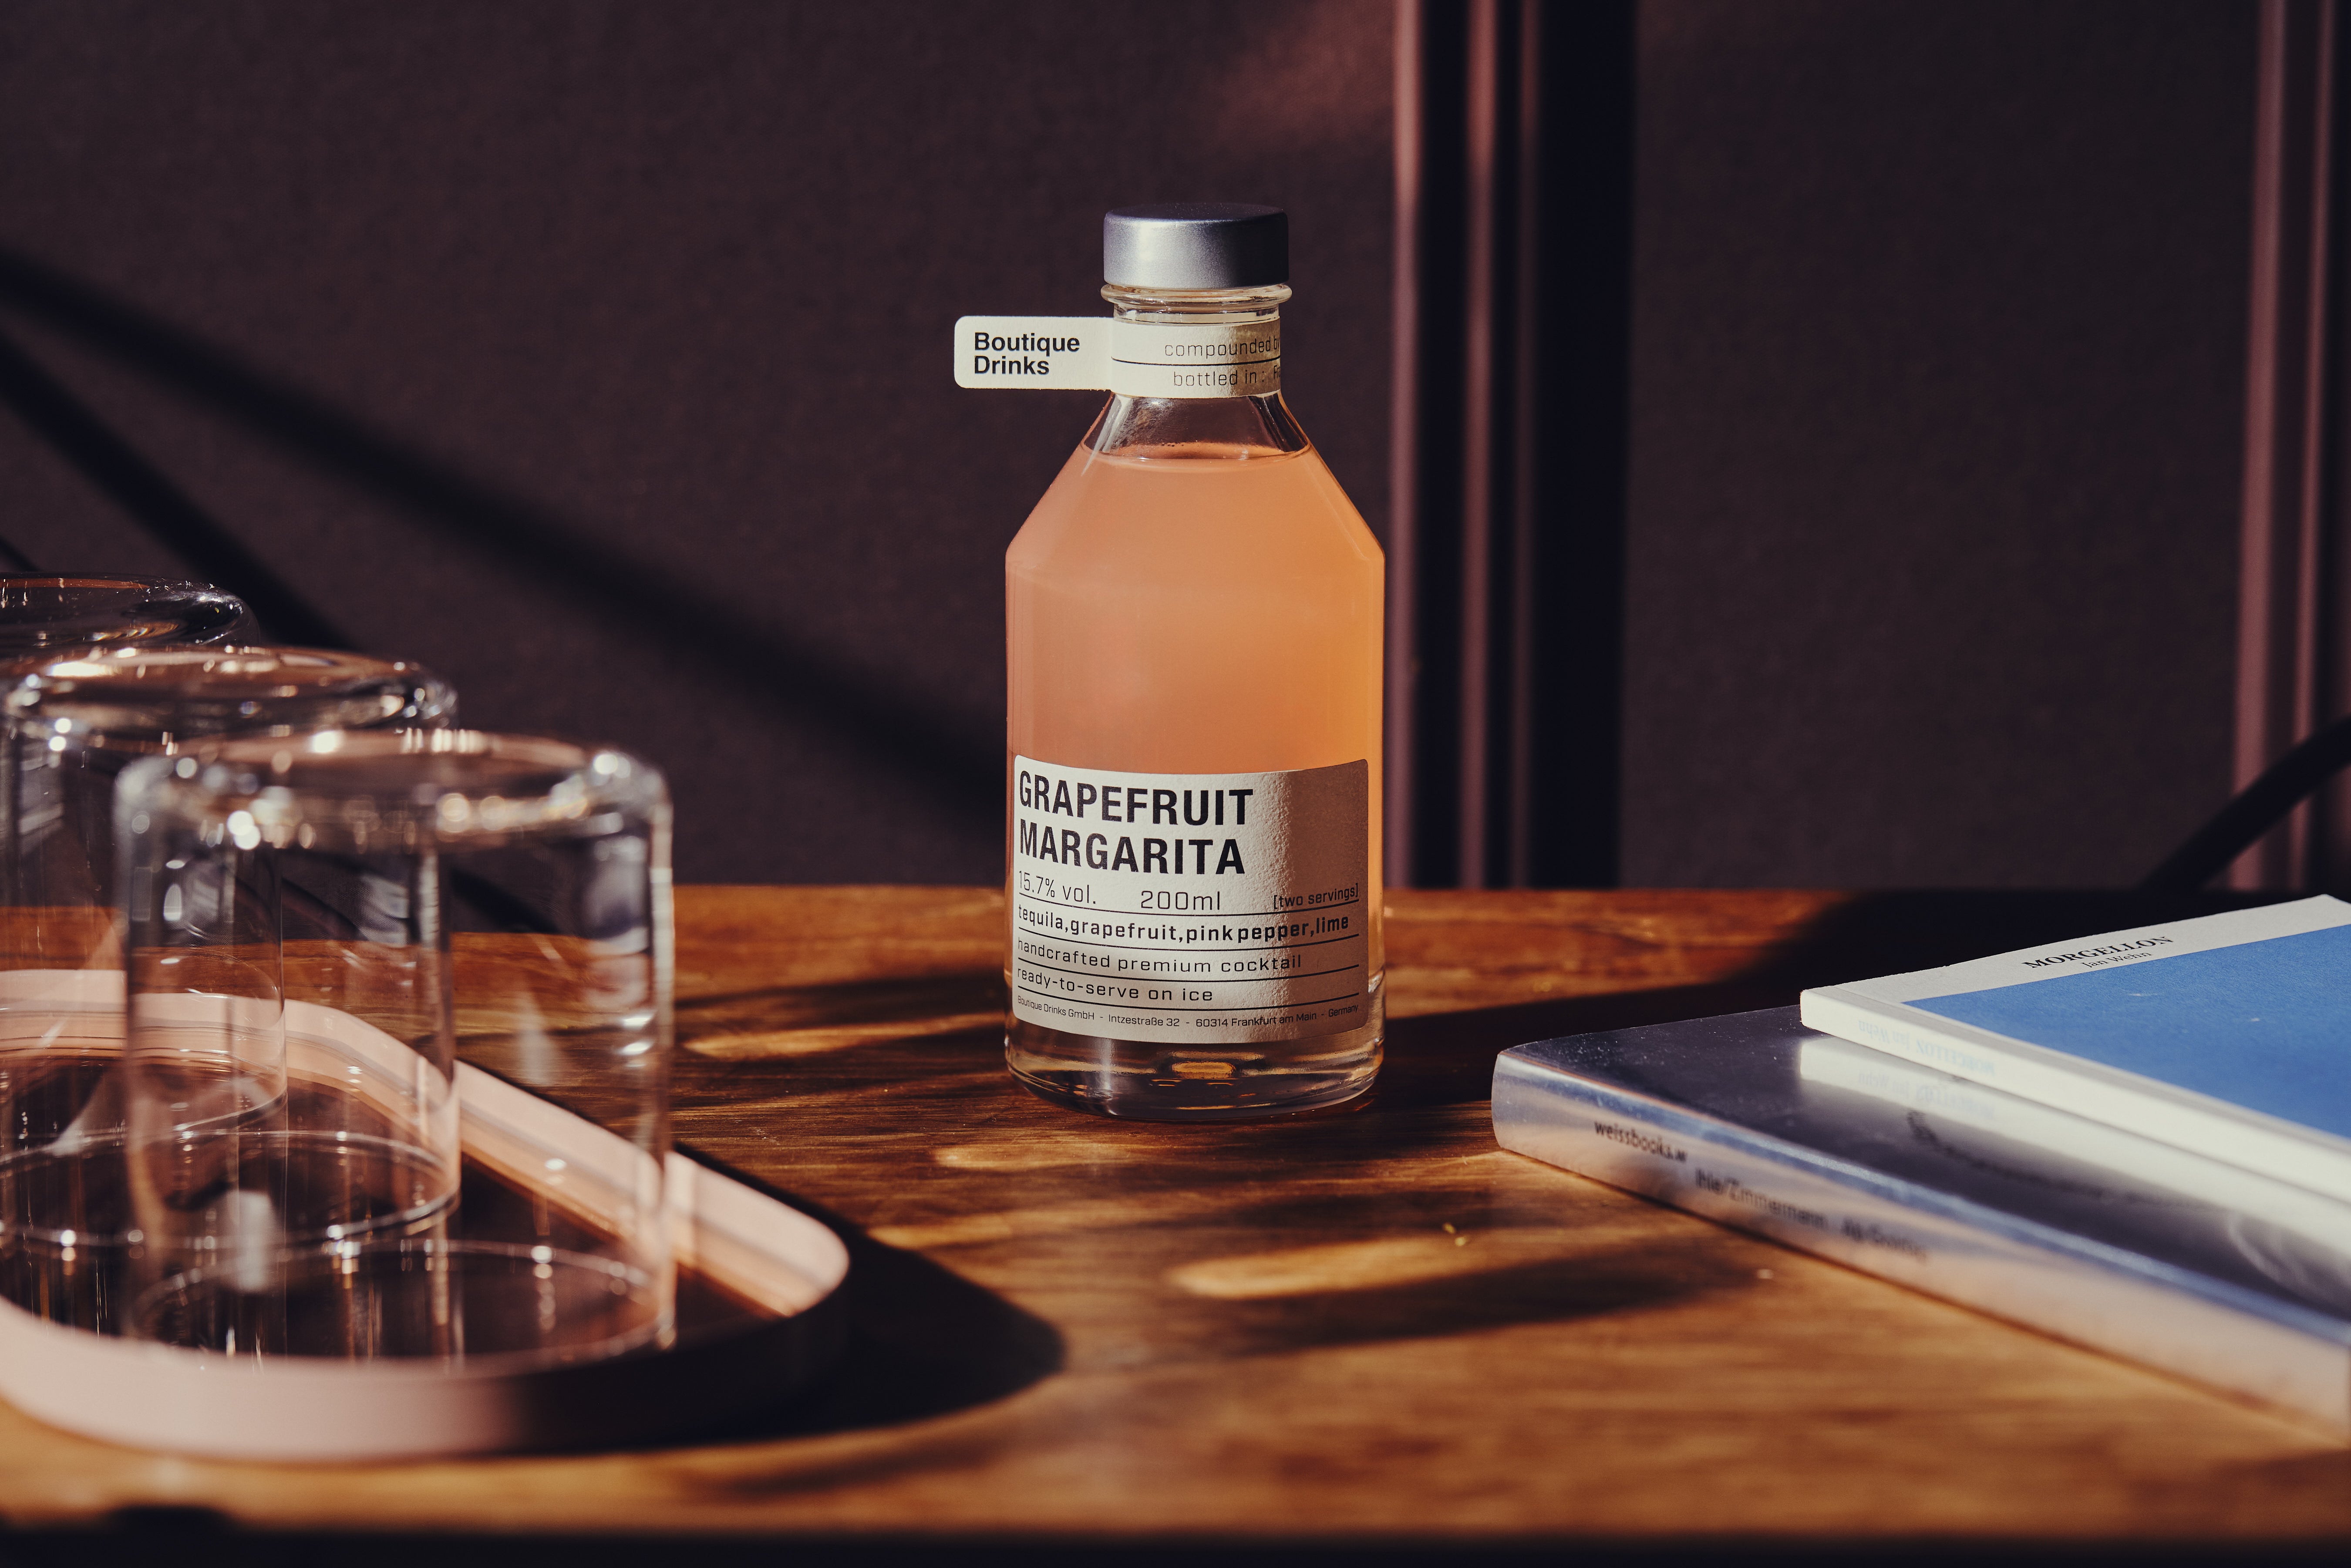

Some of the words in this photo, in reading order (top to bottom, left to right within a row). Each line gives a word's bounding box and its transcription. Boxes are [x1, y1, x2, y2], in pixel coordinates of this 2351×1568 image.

[974, 332, 1080, 357] Boutique
[1165, 336, 1271, 359] compounded
[974, 356, 1050, 375] Drinks
[1174, 370, 1237, 386] bottled
[1245, 370, 1256, 384] in
[1019, 770, 1253, 826] GRAPEFRUIT
[1020, 818, 1245, 875] MARGARITA
[1019, 870, 1055, 898] 15.7%
[1063, 885, 1096, 904] vol.
[1141, 891, 1220, 910] 200ml
[1273, 895, 1303, 910] [two
[1308, 882, 1358, 904] servings]
[1018, 936, 1110, 968] handcrafted
[1118, 959, 1211, 972] premium
[1221, 955, 1301, 972] cocktail
[2021, 936, 2173, 968] MORGELLON
[2081, 959, 2108, 968] Jan
[2107, 952, 2152, 962] Wehn
[1017, 967, 1139, 999] ready-to-serve
[1149, 989, 1172, 1000] on
[1183, 988, 1213, 1001] ice
[1017, 995, 1042, 1011] Boutique
[1044, 1003, 1066, 1016] Drinks
[1068, 1009, 1094, 1020] GmbH
[1108, 1014, 1163, 1026] Intzestraße
[1166, 1018, 1179, 1026] 32
[1196, 1019, 1228, 1027] 60314
[1231, 1016, 1276, 1026] Frankfurt
[1279, 1015, 1293, 1023] am
[1296, 1012, 1317, 1022] Main
[1328, 1004, 1359, 1017] Germany
